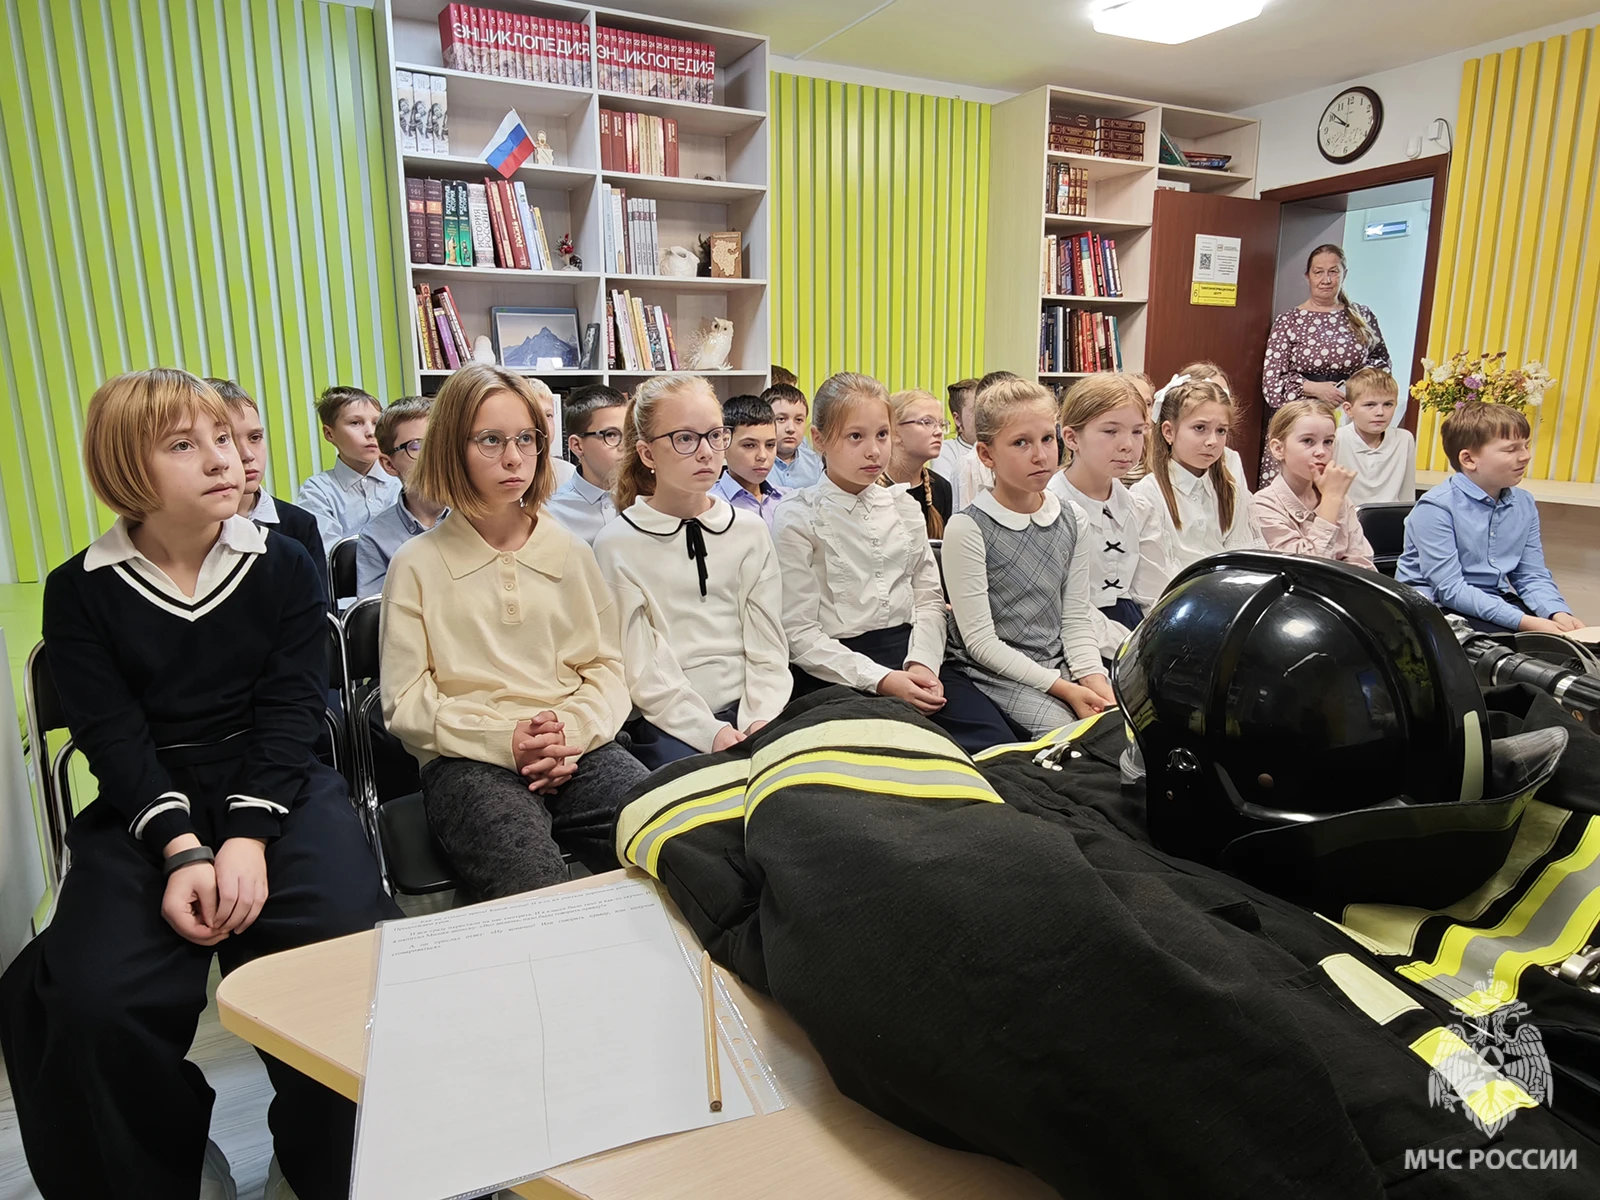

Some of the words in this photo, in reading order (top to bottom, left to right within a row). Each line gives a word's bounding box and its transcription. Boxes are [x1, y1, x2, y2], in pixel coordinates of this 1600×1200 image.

[463, 11, 468, 19] 2
[471, 14, 477, 22] 3
[481, 15, 487, 23] 4
[499, 18, 504, 26] 6
[516, 20, 521, 28] 8
[524, 22, 529, 30] 9
[531, 23, 539, 31] 10
[548, 25, 555, 33] 12
[556, 26, 563, 34] 13
[564, 27, 572, 35] 14
[573, 29, 580, 37] 15
[582, 30, 589, 38] 16
[453, 23, 590, 57] ЭНЦИКЛОПЕДИЯ
[618, 36, 625, 44] 20
[626, 37, 632, 45] 21
[633, 38, 640, 46] 22
[641, 39, 648, 47] 23
[596, 45, 715, 75] ЭНЦИКЛОПЕДИЯ
[1348, 96, 1354, 105] 12
[1337, 103, 1343, 111] 11
[1366, 105, 1371, 113] 2
[474, 208, 485, 248] ИСТОРИЯ
[480, 209, 492, 249] РОССИИ
